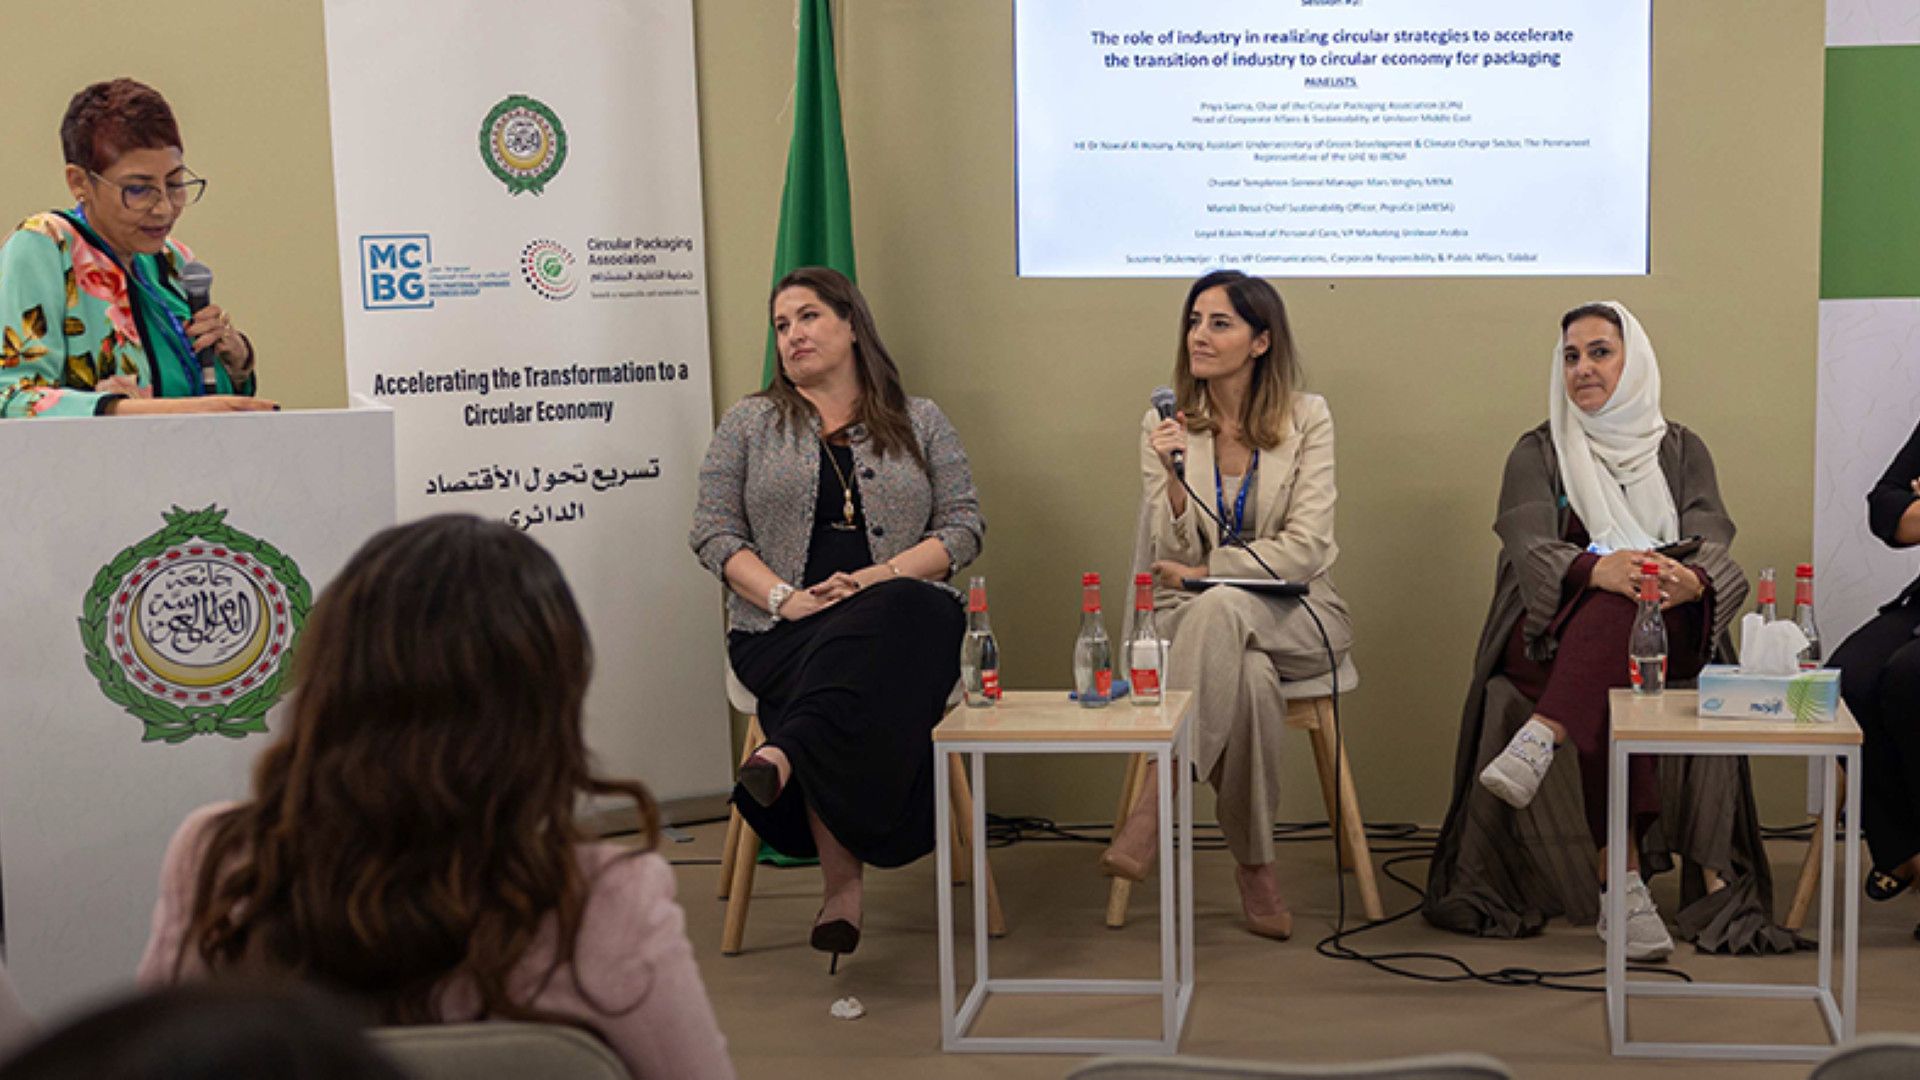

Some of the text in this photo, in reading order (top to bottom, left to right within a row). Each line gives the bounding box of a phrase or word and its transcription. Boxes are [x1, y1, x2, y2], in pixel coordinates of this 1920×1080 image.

[1091, 28, 1574, 46] The role of industry in realizing circular strategies to accelerate
[1104, 50, 1561, 69] the transition of industry to circular economy for packaging
[369, 243, 423, 270] MC
[587, 235, 693, 252] Circular Packaging
[587, 254, 657, 265] Association
[371, 272, 426, 302] BG
[374, 361, 689, 396] Accelerating the Transformation to a
[464, 400, 615, 427] Circular Economy
[524, 462, 588, 492] تحول
[591, 458, 661, 492] تسريع
